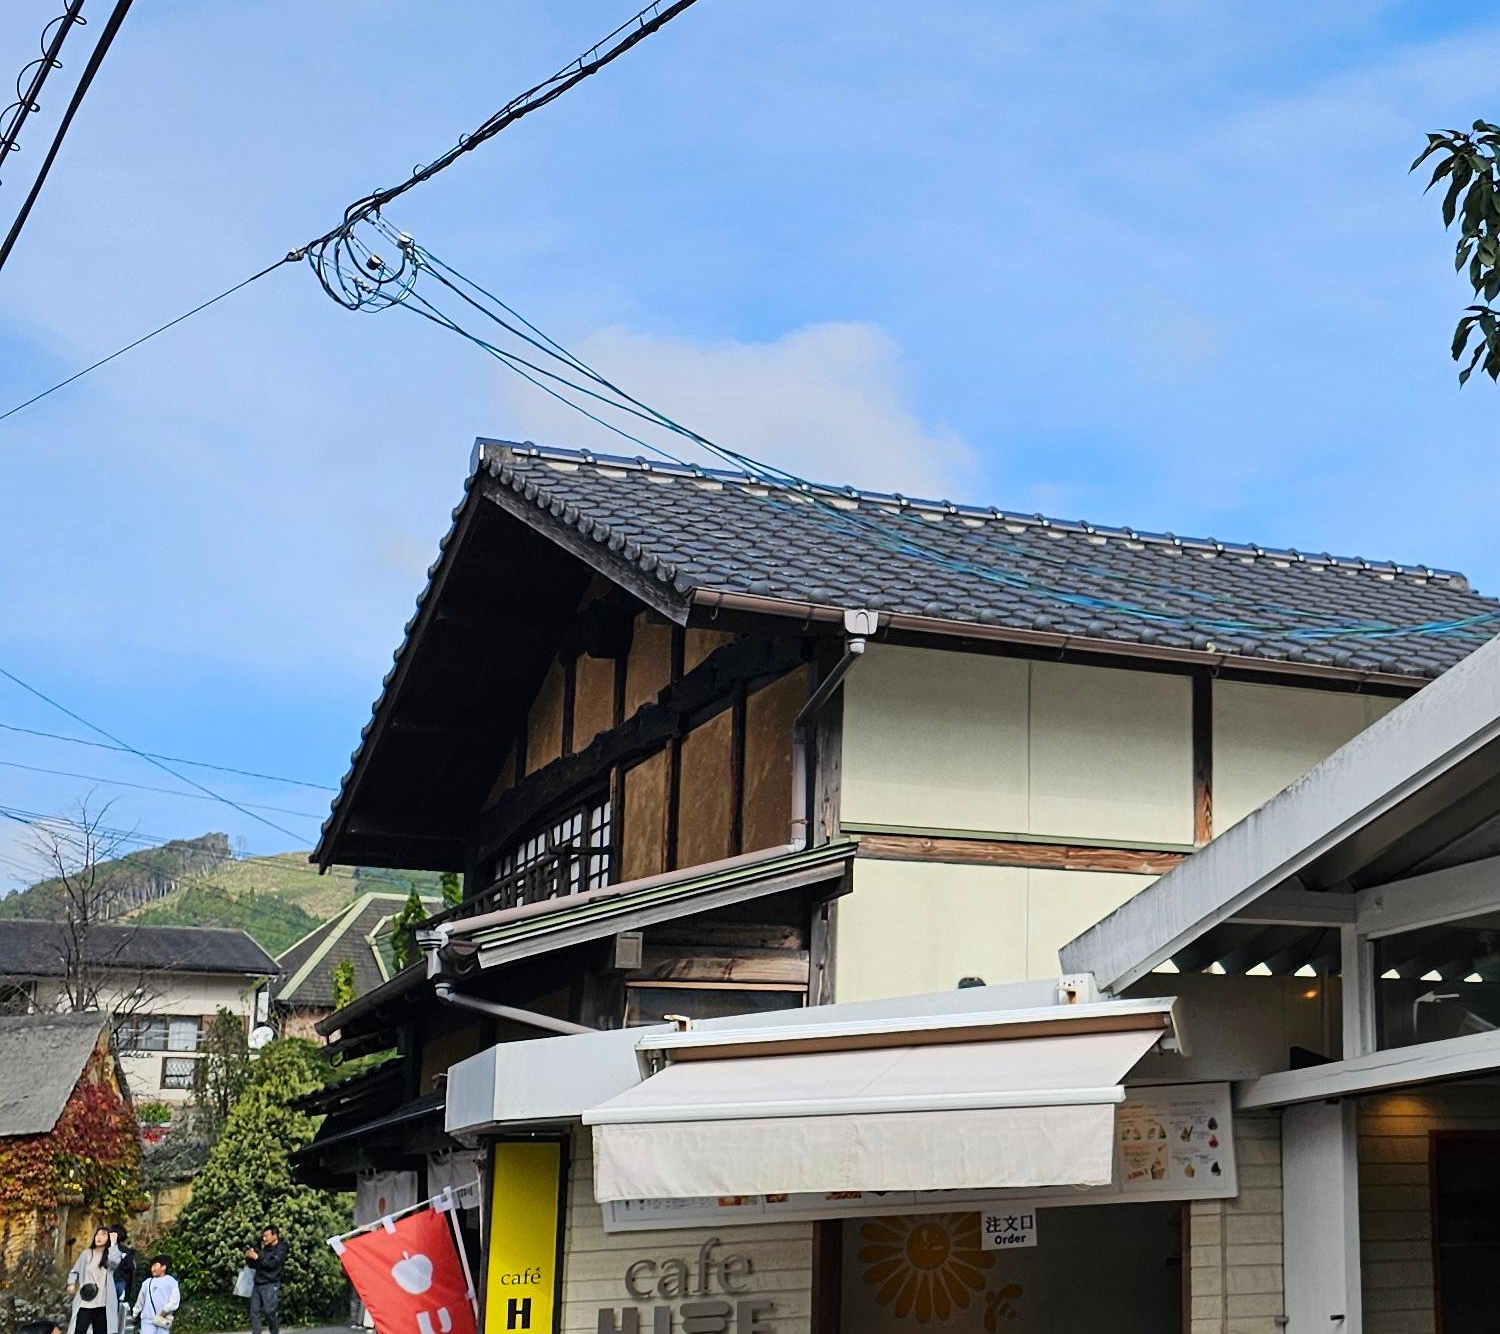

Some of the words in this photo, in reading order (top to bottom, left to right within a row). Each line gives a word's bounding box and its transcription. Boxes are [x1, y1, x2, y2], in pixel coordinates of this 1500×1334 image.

[985, 1214, 1034, 1234] 注文口
[994, 1233, 1027, 1245] Order
[501, 1267, 541, 1286] café
